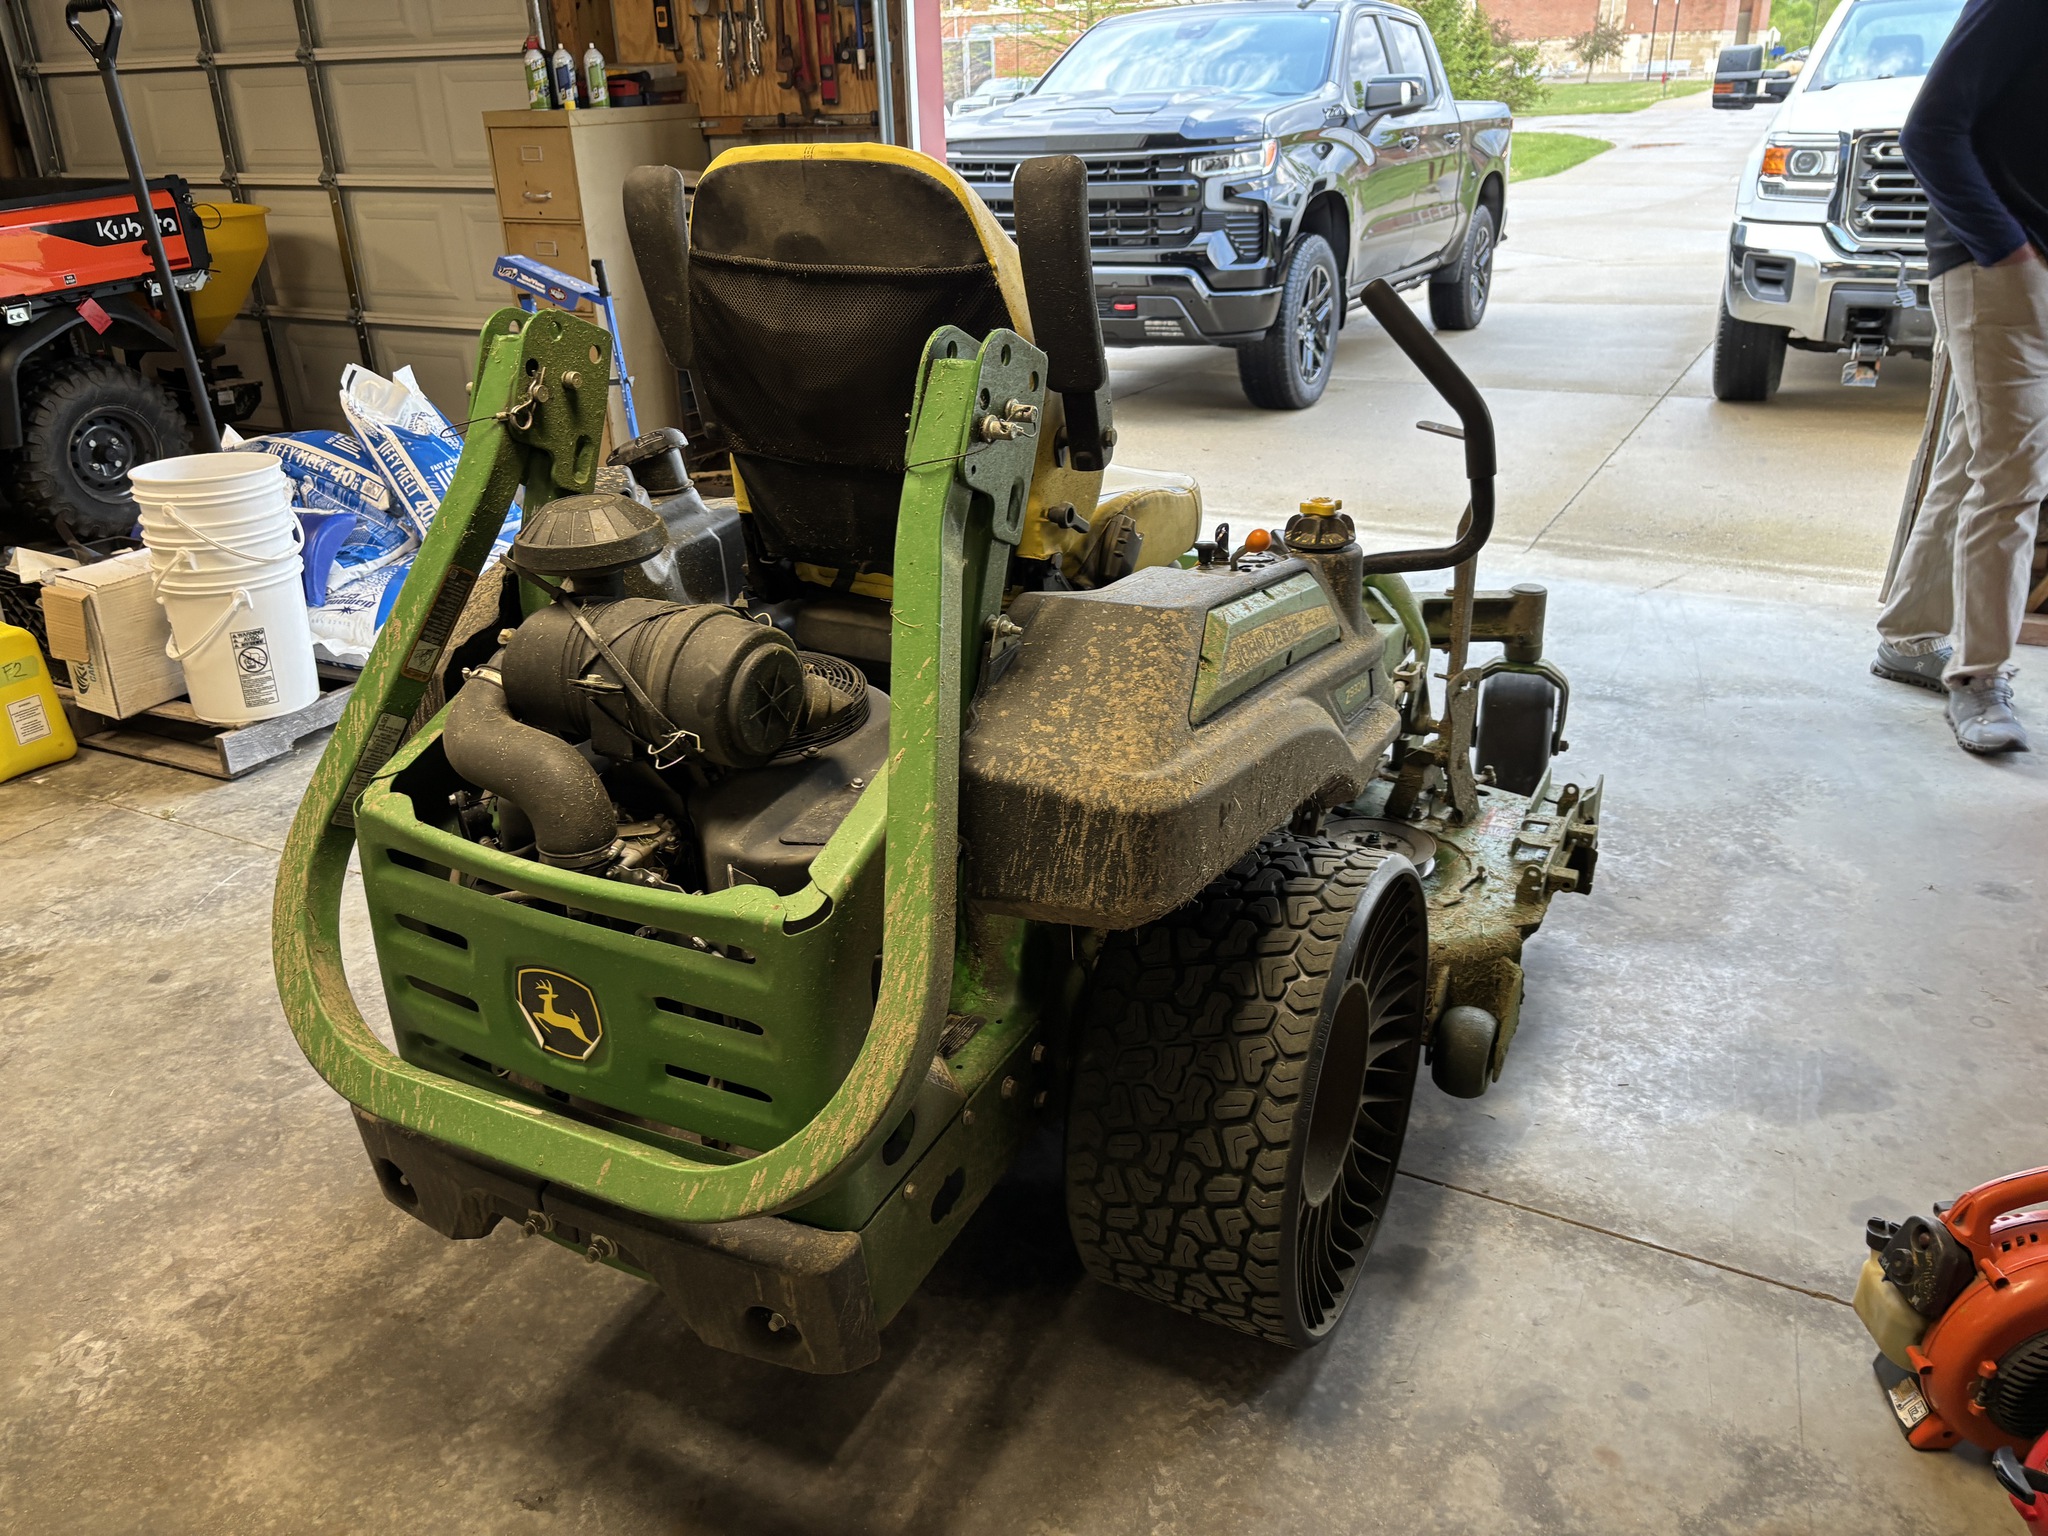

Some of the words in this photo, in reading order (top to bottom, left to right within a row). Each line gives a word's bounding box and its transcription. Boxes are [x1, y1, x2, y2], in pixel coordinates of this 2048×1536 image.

[96, 213, 177, 241] Kubta
[330, 465, 357, 487] 40
[376, 440, 403, 466] JIFFY
[395, 465, 421, 498] MELT
[2, 662, 27, 681] F2
